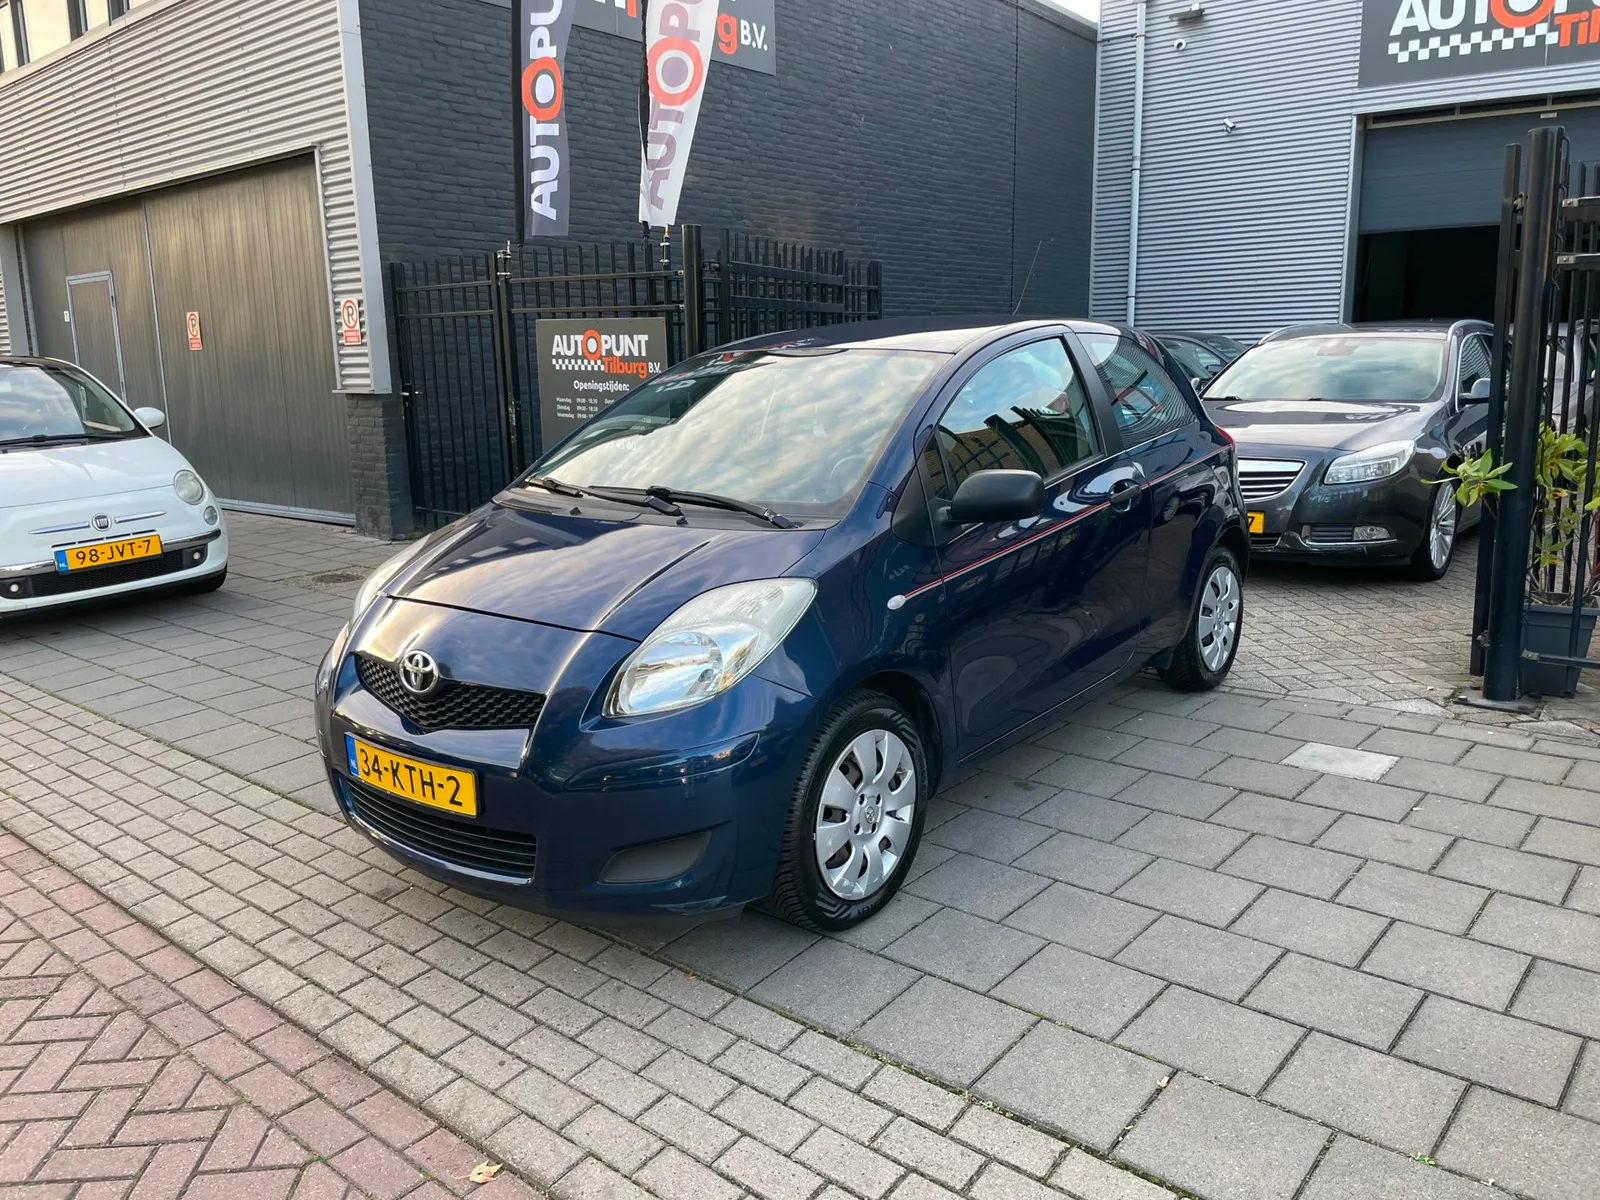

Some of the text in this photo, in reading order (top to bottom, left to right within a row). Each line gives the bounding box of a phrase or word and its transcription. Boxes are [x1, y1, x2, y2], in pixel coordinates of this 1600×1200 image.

[740, 19, 768, 51] B.V.
[647, 0, 704, 211] AUTOP
[552, 329, 648, 361] AUTOPUNT
[602, 357, 648, 379] Tilburg
[648, 362, 661, 374] B.V.
[573, 380, 630, 392] Openingstijden:
[75, 539, 151, 565] 98-JVT-7
[360, 748, 463, 807] 34-KTH-2
